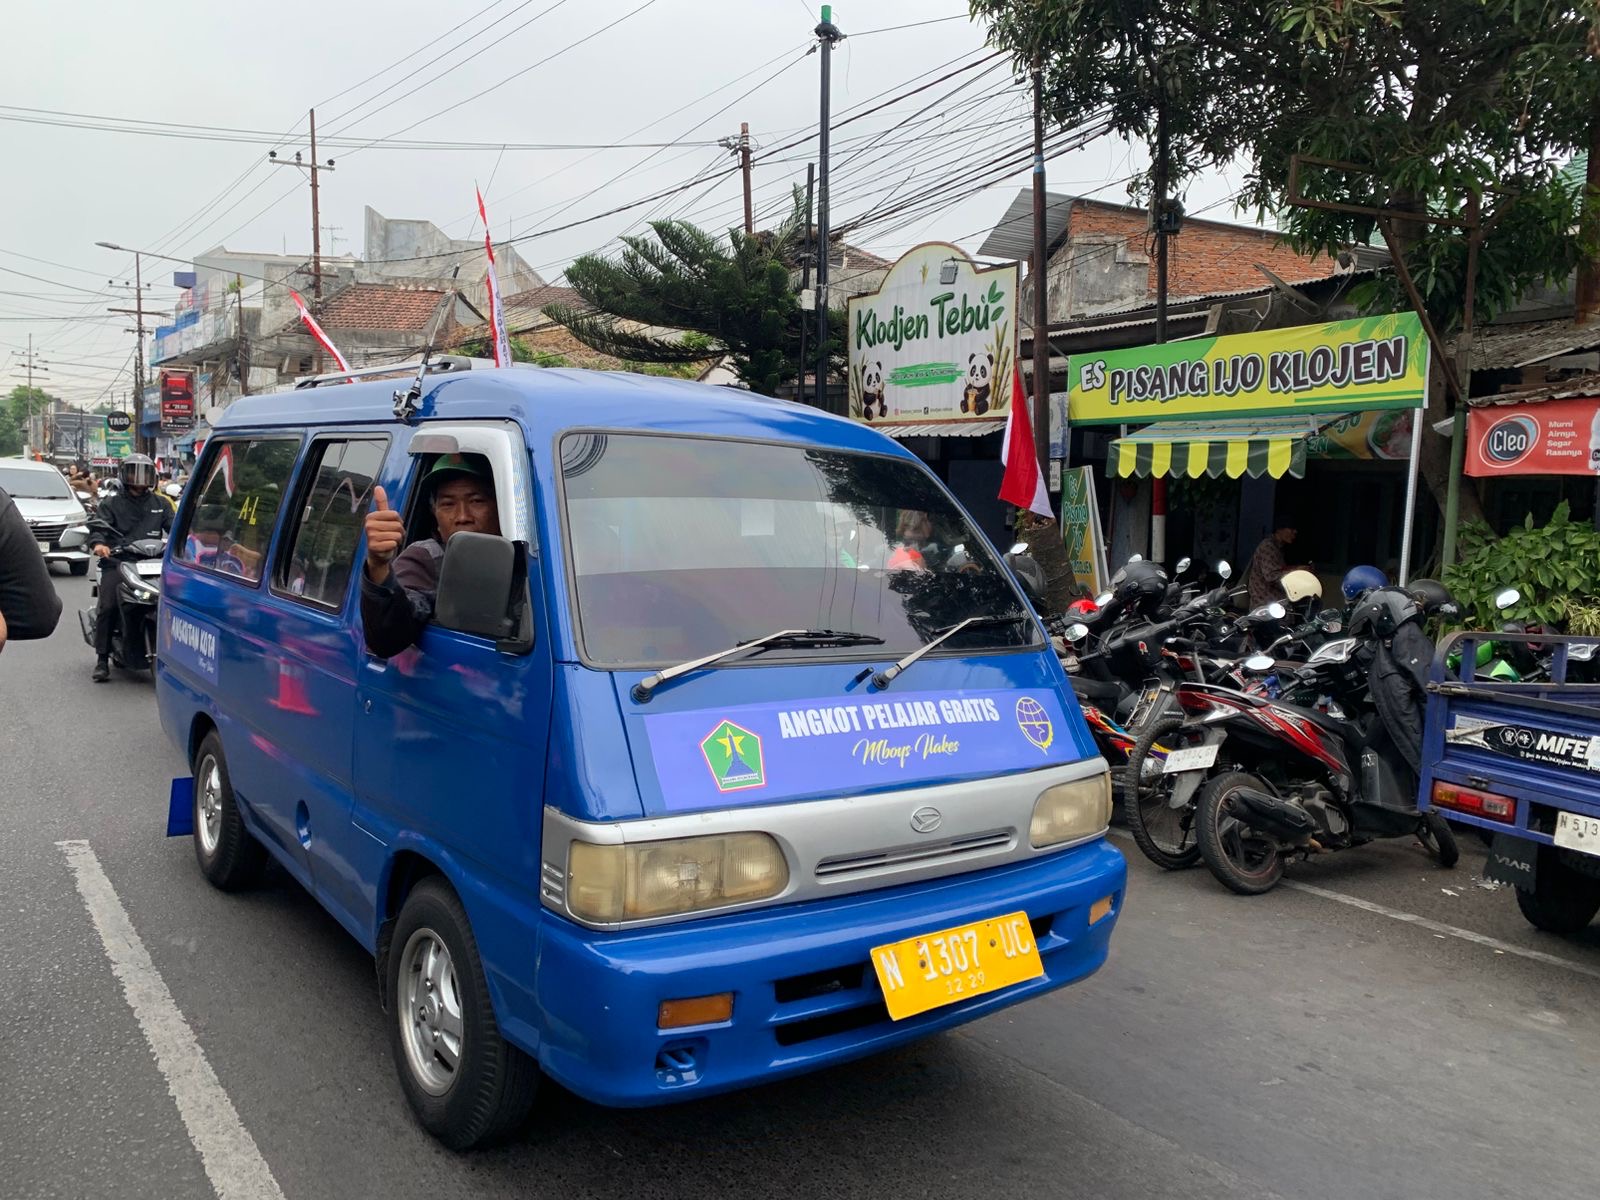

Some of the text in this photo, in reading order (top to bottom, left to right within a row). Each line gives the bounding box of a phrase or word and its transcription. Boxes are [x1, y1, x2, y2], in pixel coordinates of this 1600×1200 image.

[856, 305, 928, 351] Klodjen
[1080, 336, 1406, 403] ES PISANG IJO KLOJEN
[1547, 430, 1578, 439] Airnya,
[1548, 420, 1573, 428] Murni
[1493, 430, 1527, 452] Cleo
[1546, 440, 1572, 448] Segar
[200, 628, 216, 660] KOTA
[778, 698, 1000, 739] ANGKOT PELAJAR GRATIS
[1560, 815, 1566, 828] N
[1495, 854, 1531, 873] VIAR
[880, 920, 1031, 991] N 1307 UC
